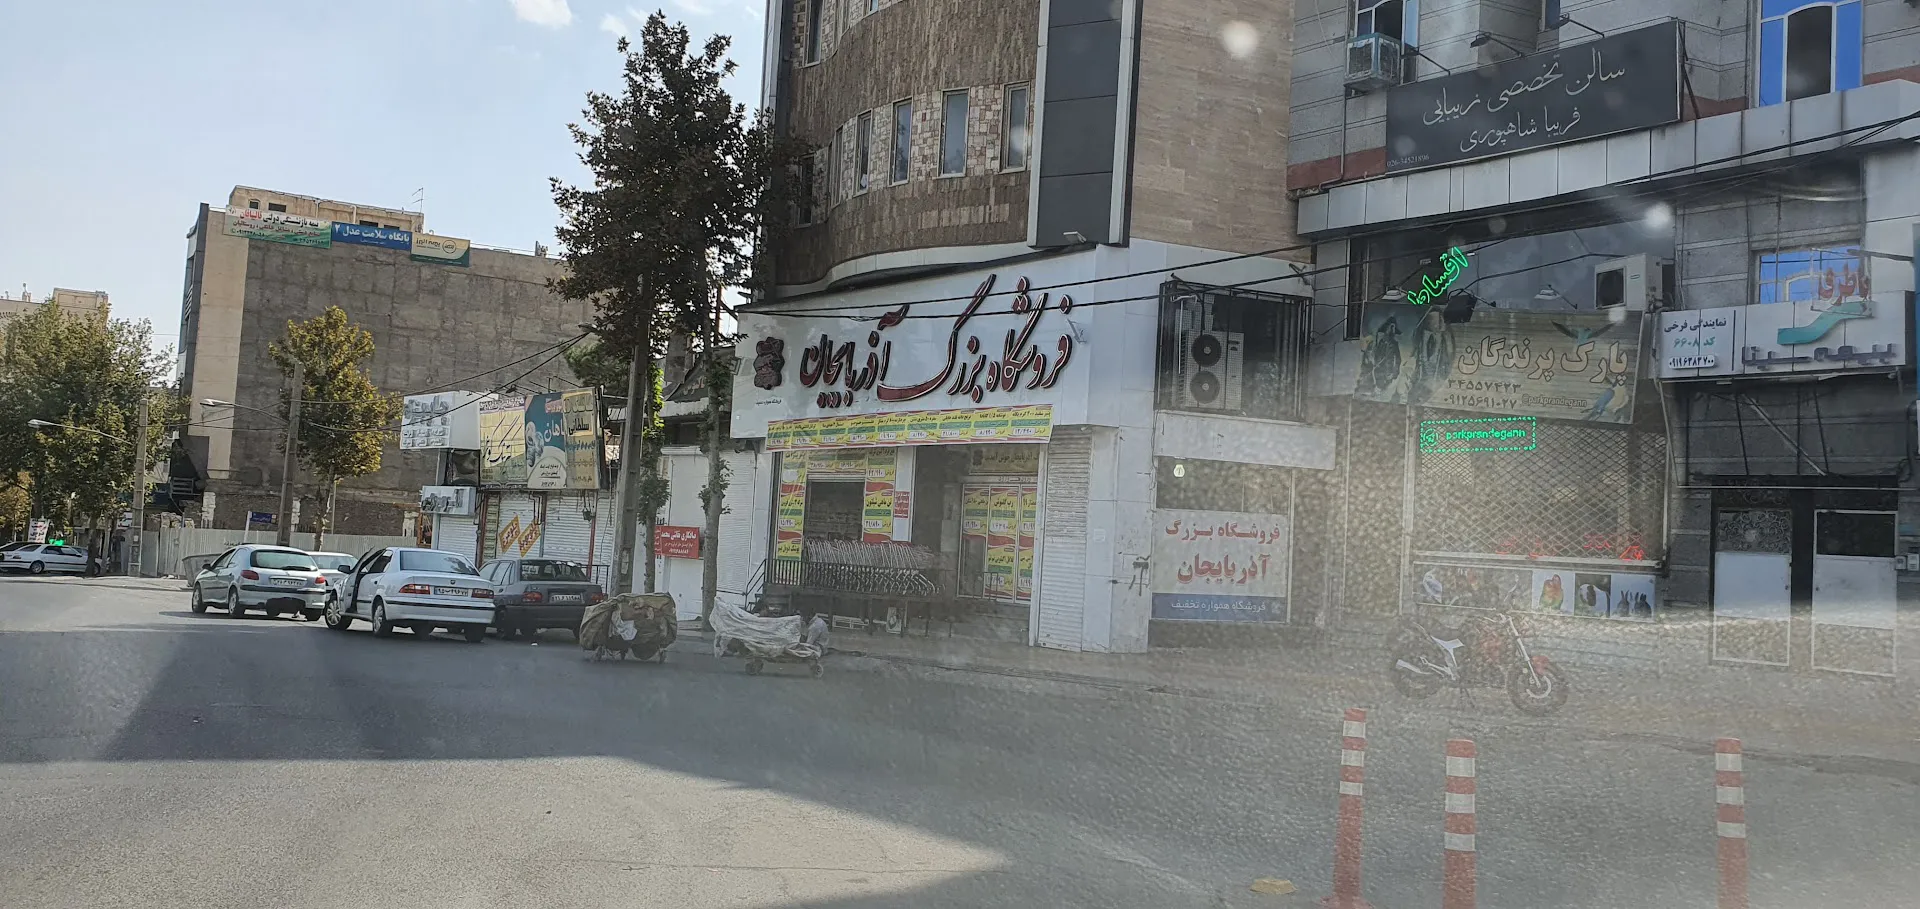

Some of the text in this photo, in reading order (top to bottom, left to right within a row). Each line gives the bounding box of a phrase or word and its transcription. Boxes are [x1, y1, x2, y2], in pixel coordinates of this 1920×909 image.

[1423, 47, 1626, 126] سالن تخصصی زیبایی
[1459, 106, 1582, 153] فریبا شاهپوری
[342, 225, 361, 237] عدل
[361, 229, 388, 240] سلامت
[388, 230, 411, 244] پایگاه
[1407, 246, 1469, 305] اقساط
[1664, 317, 1727, 333] نمایندگی فرخی
[800, 273, 1074, 408] فروشگاه بزرگ آذربایجان
[1703, 336, 1716, 347] کد
[1457, 334, 1628, 387] پارک پرندگان
[1741, 342, 1897, 371] بیمه سینا
[1444, 393, 1519, 410] ۰۹۱۲۵۶۹۱۰۲۷
[1165, 519, 1280, 544] فروشگاه بزرگ
[1177, 552, 1271, 584] آذربایجان
[1171, 600, 1266, 613] فروشگاه همواره تخفیف
